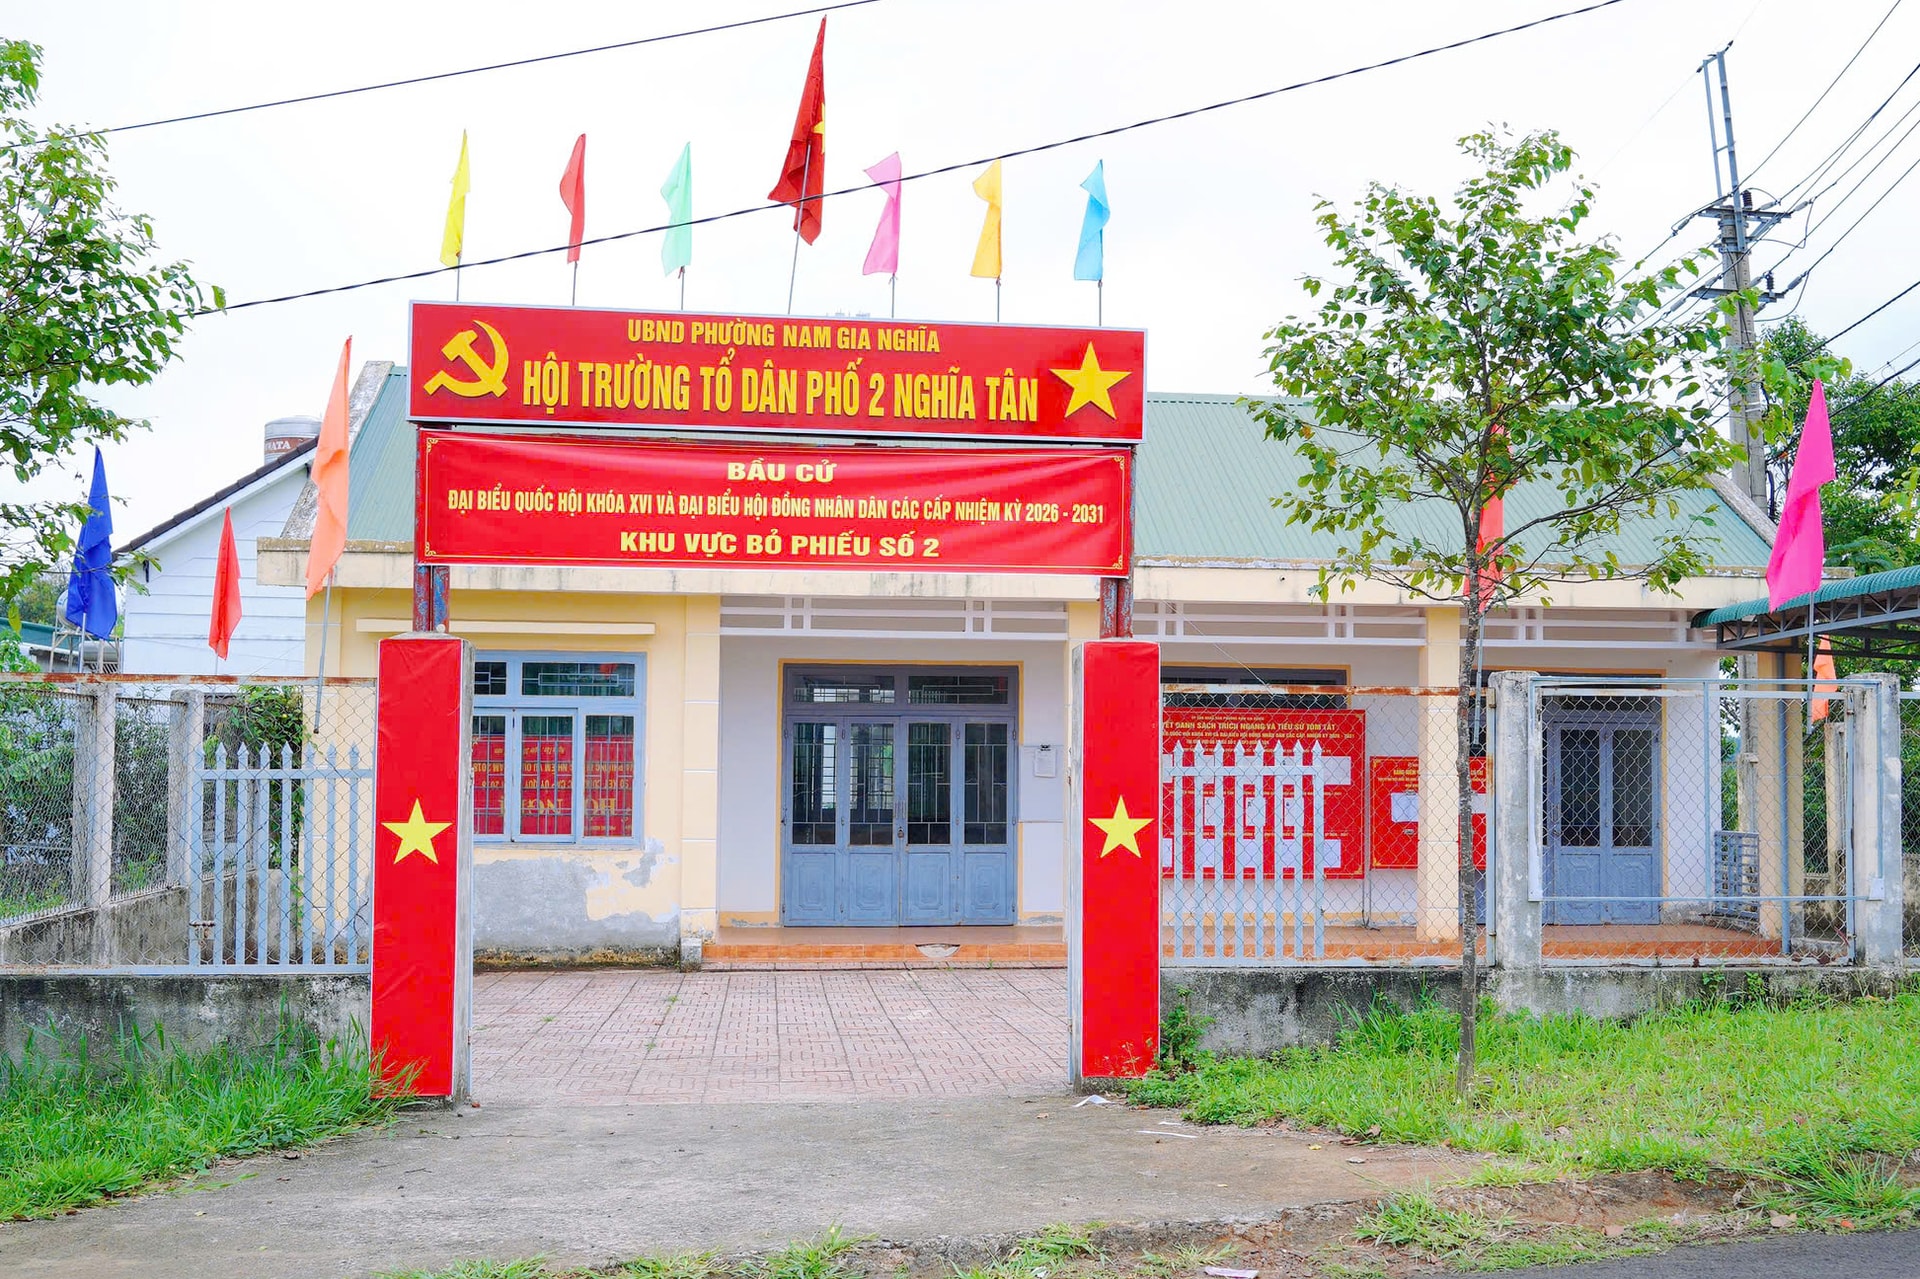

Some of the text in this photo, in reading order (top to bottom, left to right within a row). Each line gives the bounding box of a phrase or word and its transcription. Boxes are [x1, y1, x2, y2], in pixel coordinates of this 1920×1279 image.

[628, 318, 941, 353] UBND PHƯỜNG NAM GIA NGHĨA
[523, 348, 1038, 422] HỘI TRƯỜNG TỔ DÂN PHỐ 2 NGHĨA TÂN
[728, 457, 838, 482] BẦU CỬ
[448, 489, 474, 514] ĐẠI
[477, 483, 511, 510] BIỂU
[515, 484, 554, 513] QUỐC
[558, 488, 582, 517] HỘI
[586, 490, 625, 513] KHÓA
[629, 495, 653, 513] XVI
[656, 490, 675, 514] VÀ
[679, 494, 703, 517] ĐẠI
[707, 487, 739, 516] BIỂU
[743, 491, 768, 521] HỘI
[772, 492, 811, 519] ĐỒNG
[815, 494, 854, 519] NHÂN
[858, 496, 887, 519] DÂN
[891, 496, 919, 520] CÁC
[924, 494, 951, 520] CẤP
[955, 498, 1000, 525] NHIỆM
[1004, 499, 1023, 522] KỲ
[1026, 503, 1059, 523] 2026
[1072, 504, 1104, 524] 2031
[620, 529, 939, 558] KHU VỰC BỎ PHIẾU SỐ 2
